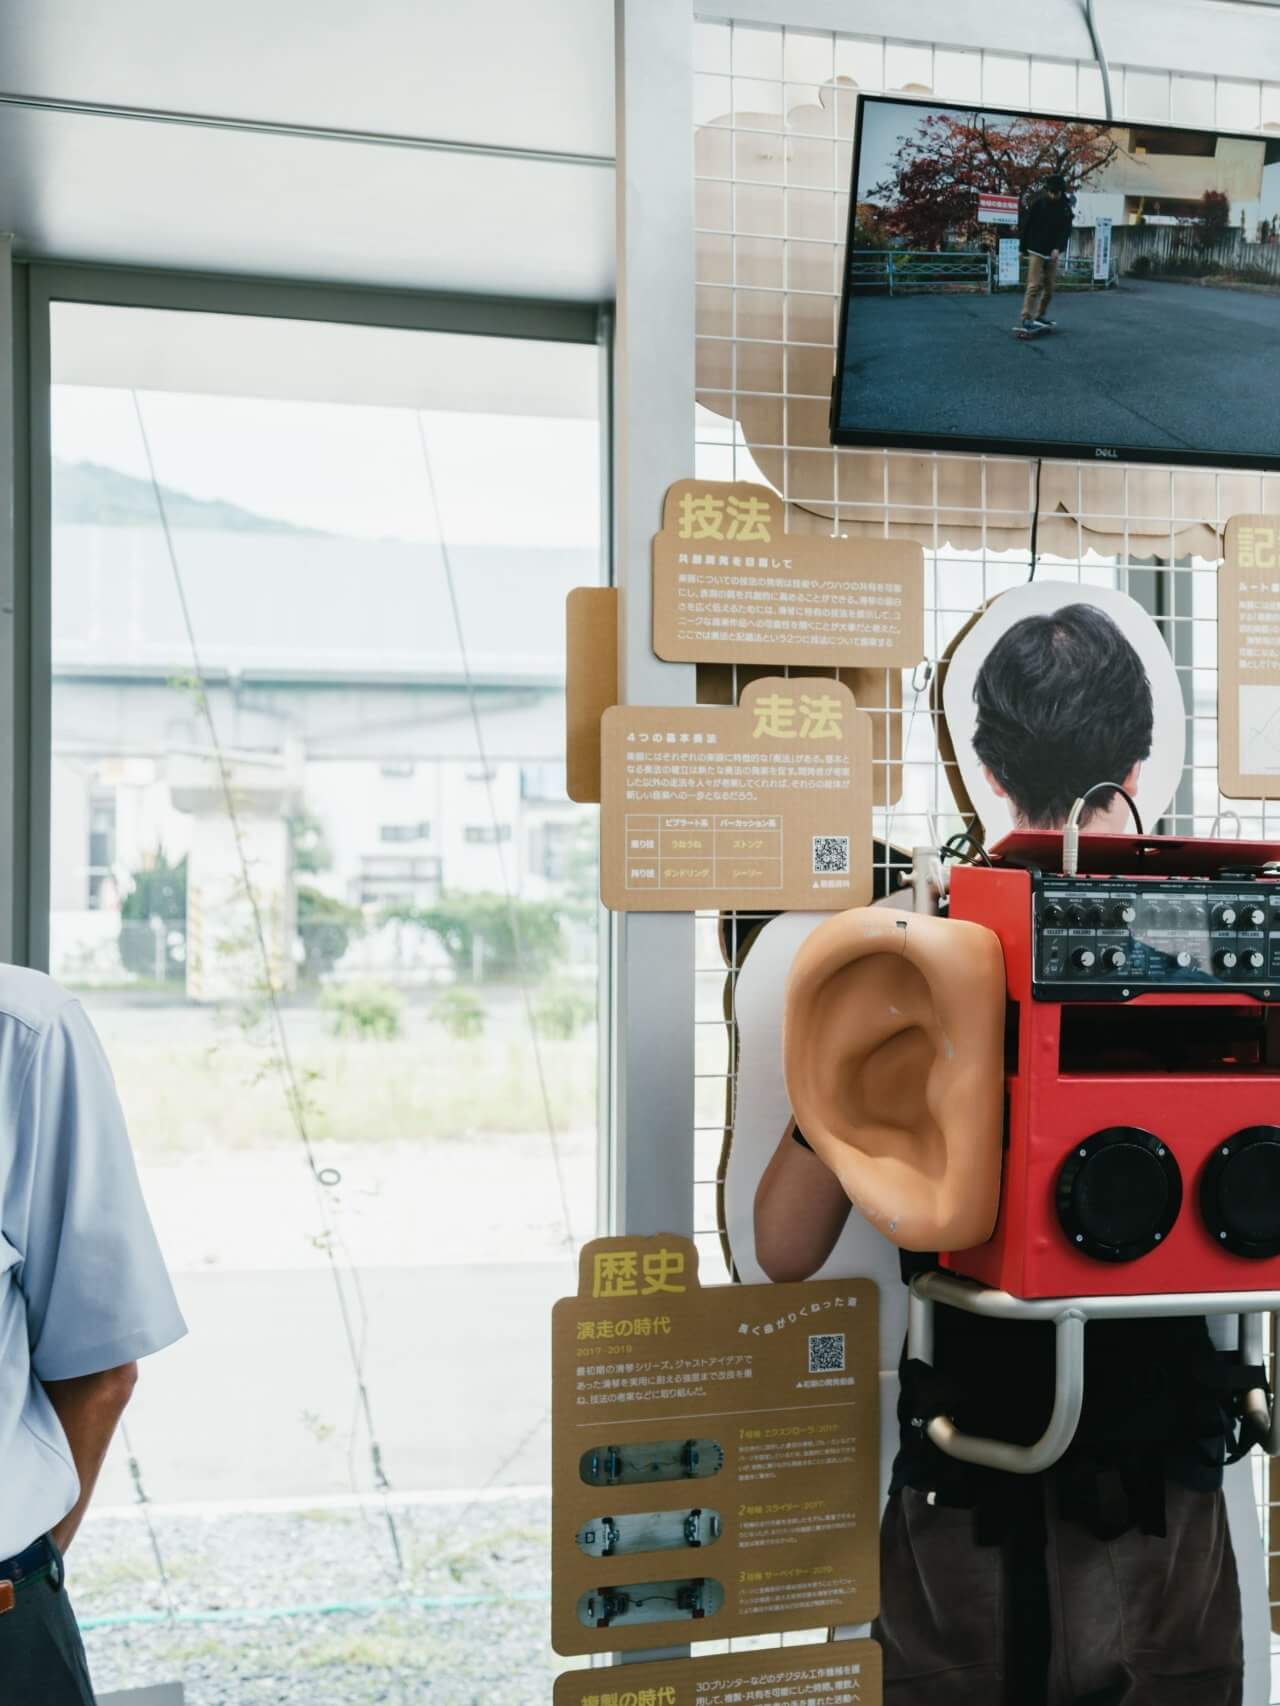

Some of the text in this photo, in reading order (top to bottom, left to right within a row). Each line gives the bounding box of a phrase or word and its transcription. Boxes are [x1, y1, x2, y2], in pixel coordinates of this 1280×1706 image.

[1095, 447, 1119, 458] DELL
[678, 492, 771, 544] 技法
[752, 693, 844, 741] 走法
[592, 1247, 687, 1299] 歴史
